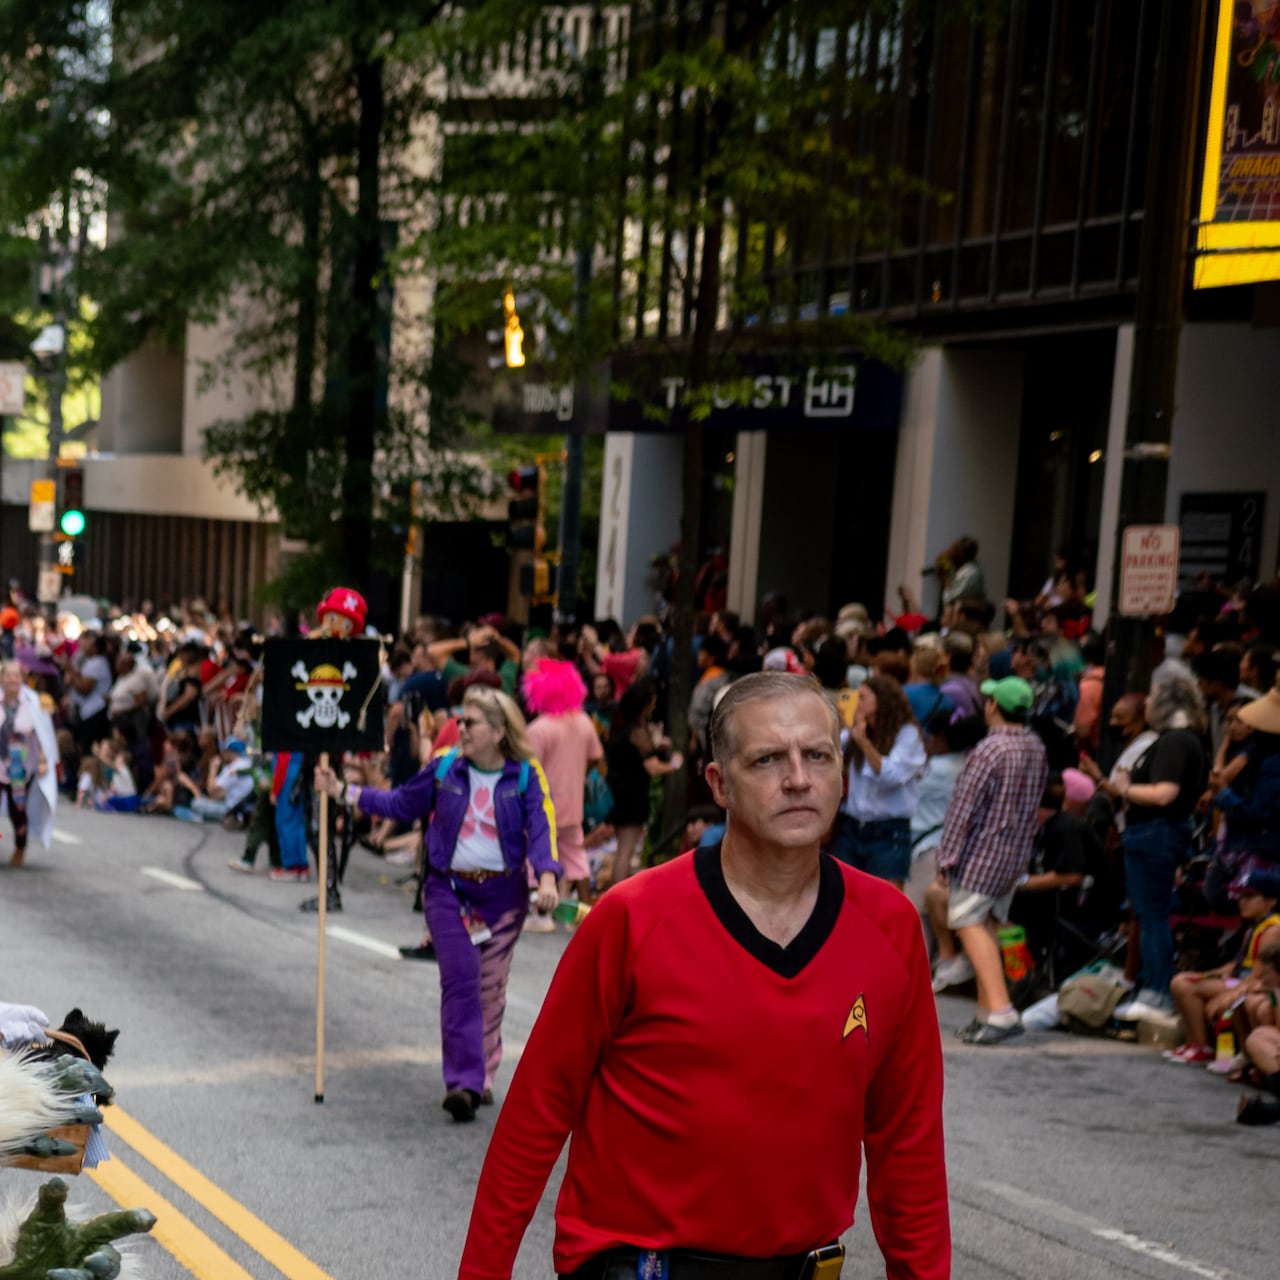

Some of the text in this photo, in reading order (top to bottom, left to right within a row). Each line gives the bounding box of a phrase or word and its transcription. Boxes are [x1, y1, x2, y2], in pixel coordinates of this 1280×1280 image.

[660, 374, 793, 410] TUIST
[1140, 534, 1162, 551] NO
[1126, 552, 1173, 569] PARKING
